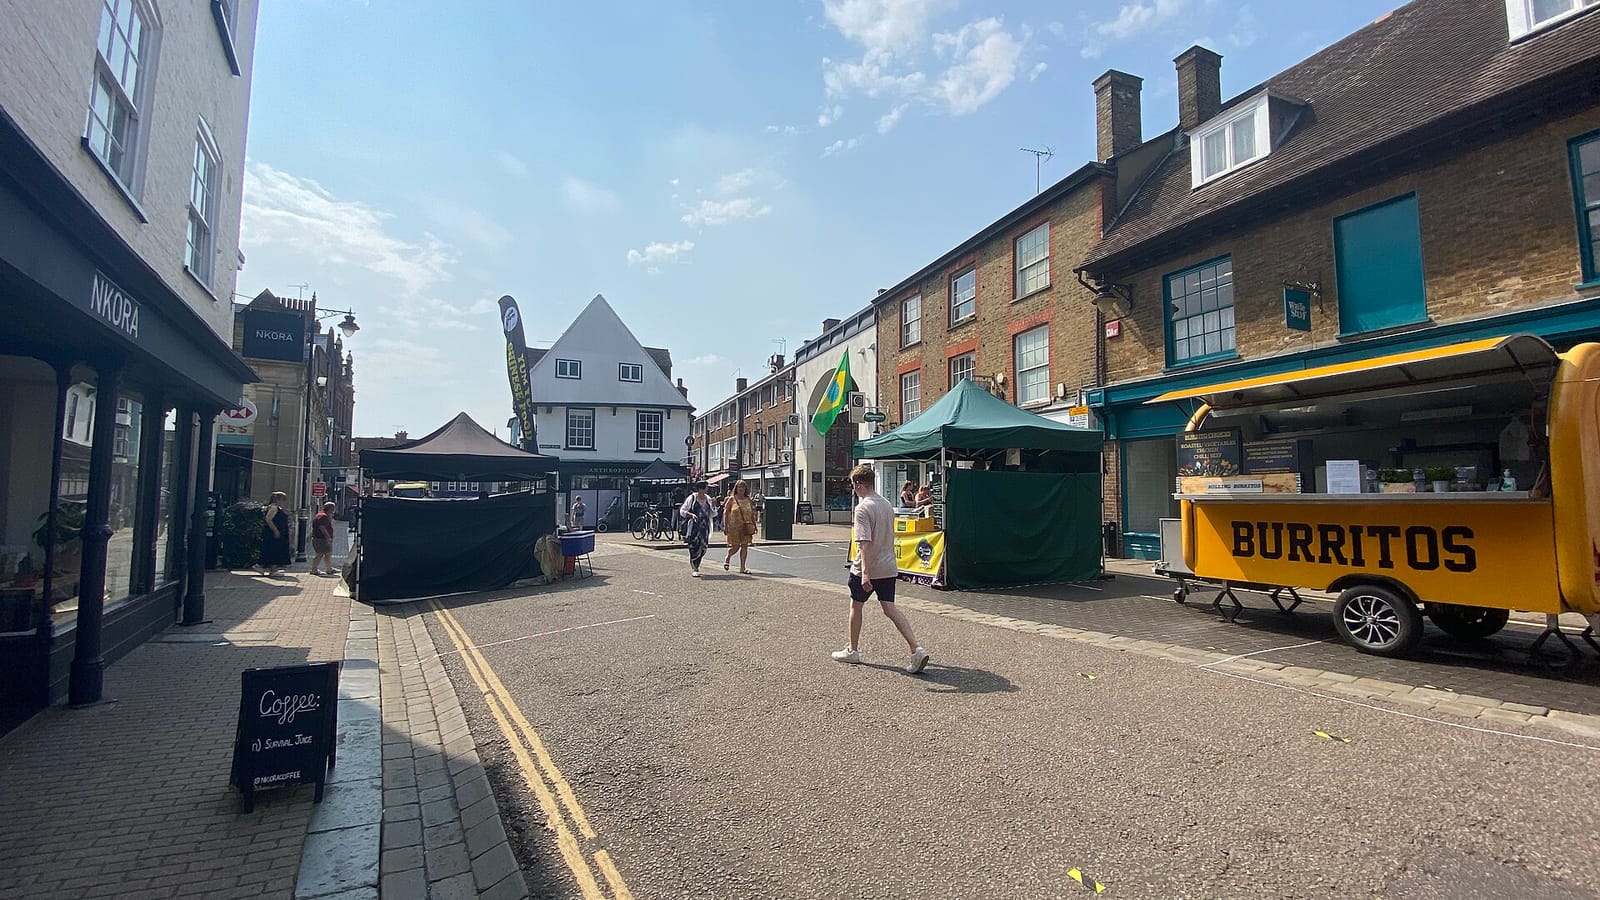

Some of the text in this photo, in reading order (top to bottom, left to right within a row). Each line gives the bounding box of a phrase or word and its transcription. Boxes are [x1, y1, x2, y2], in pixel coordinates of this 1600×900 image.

[90, 274, 139, 339] NKORA
[256, 329, 294, 342] NKORA
[507, 342, 524, 401] CHINESE
[1231, 520, 1477, 573] BURRITOS
[260, 690, 321, 725] Coffee:
